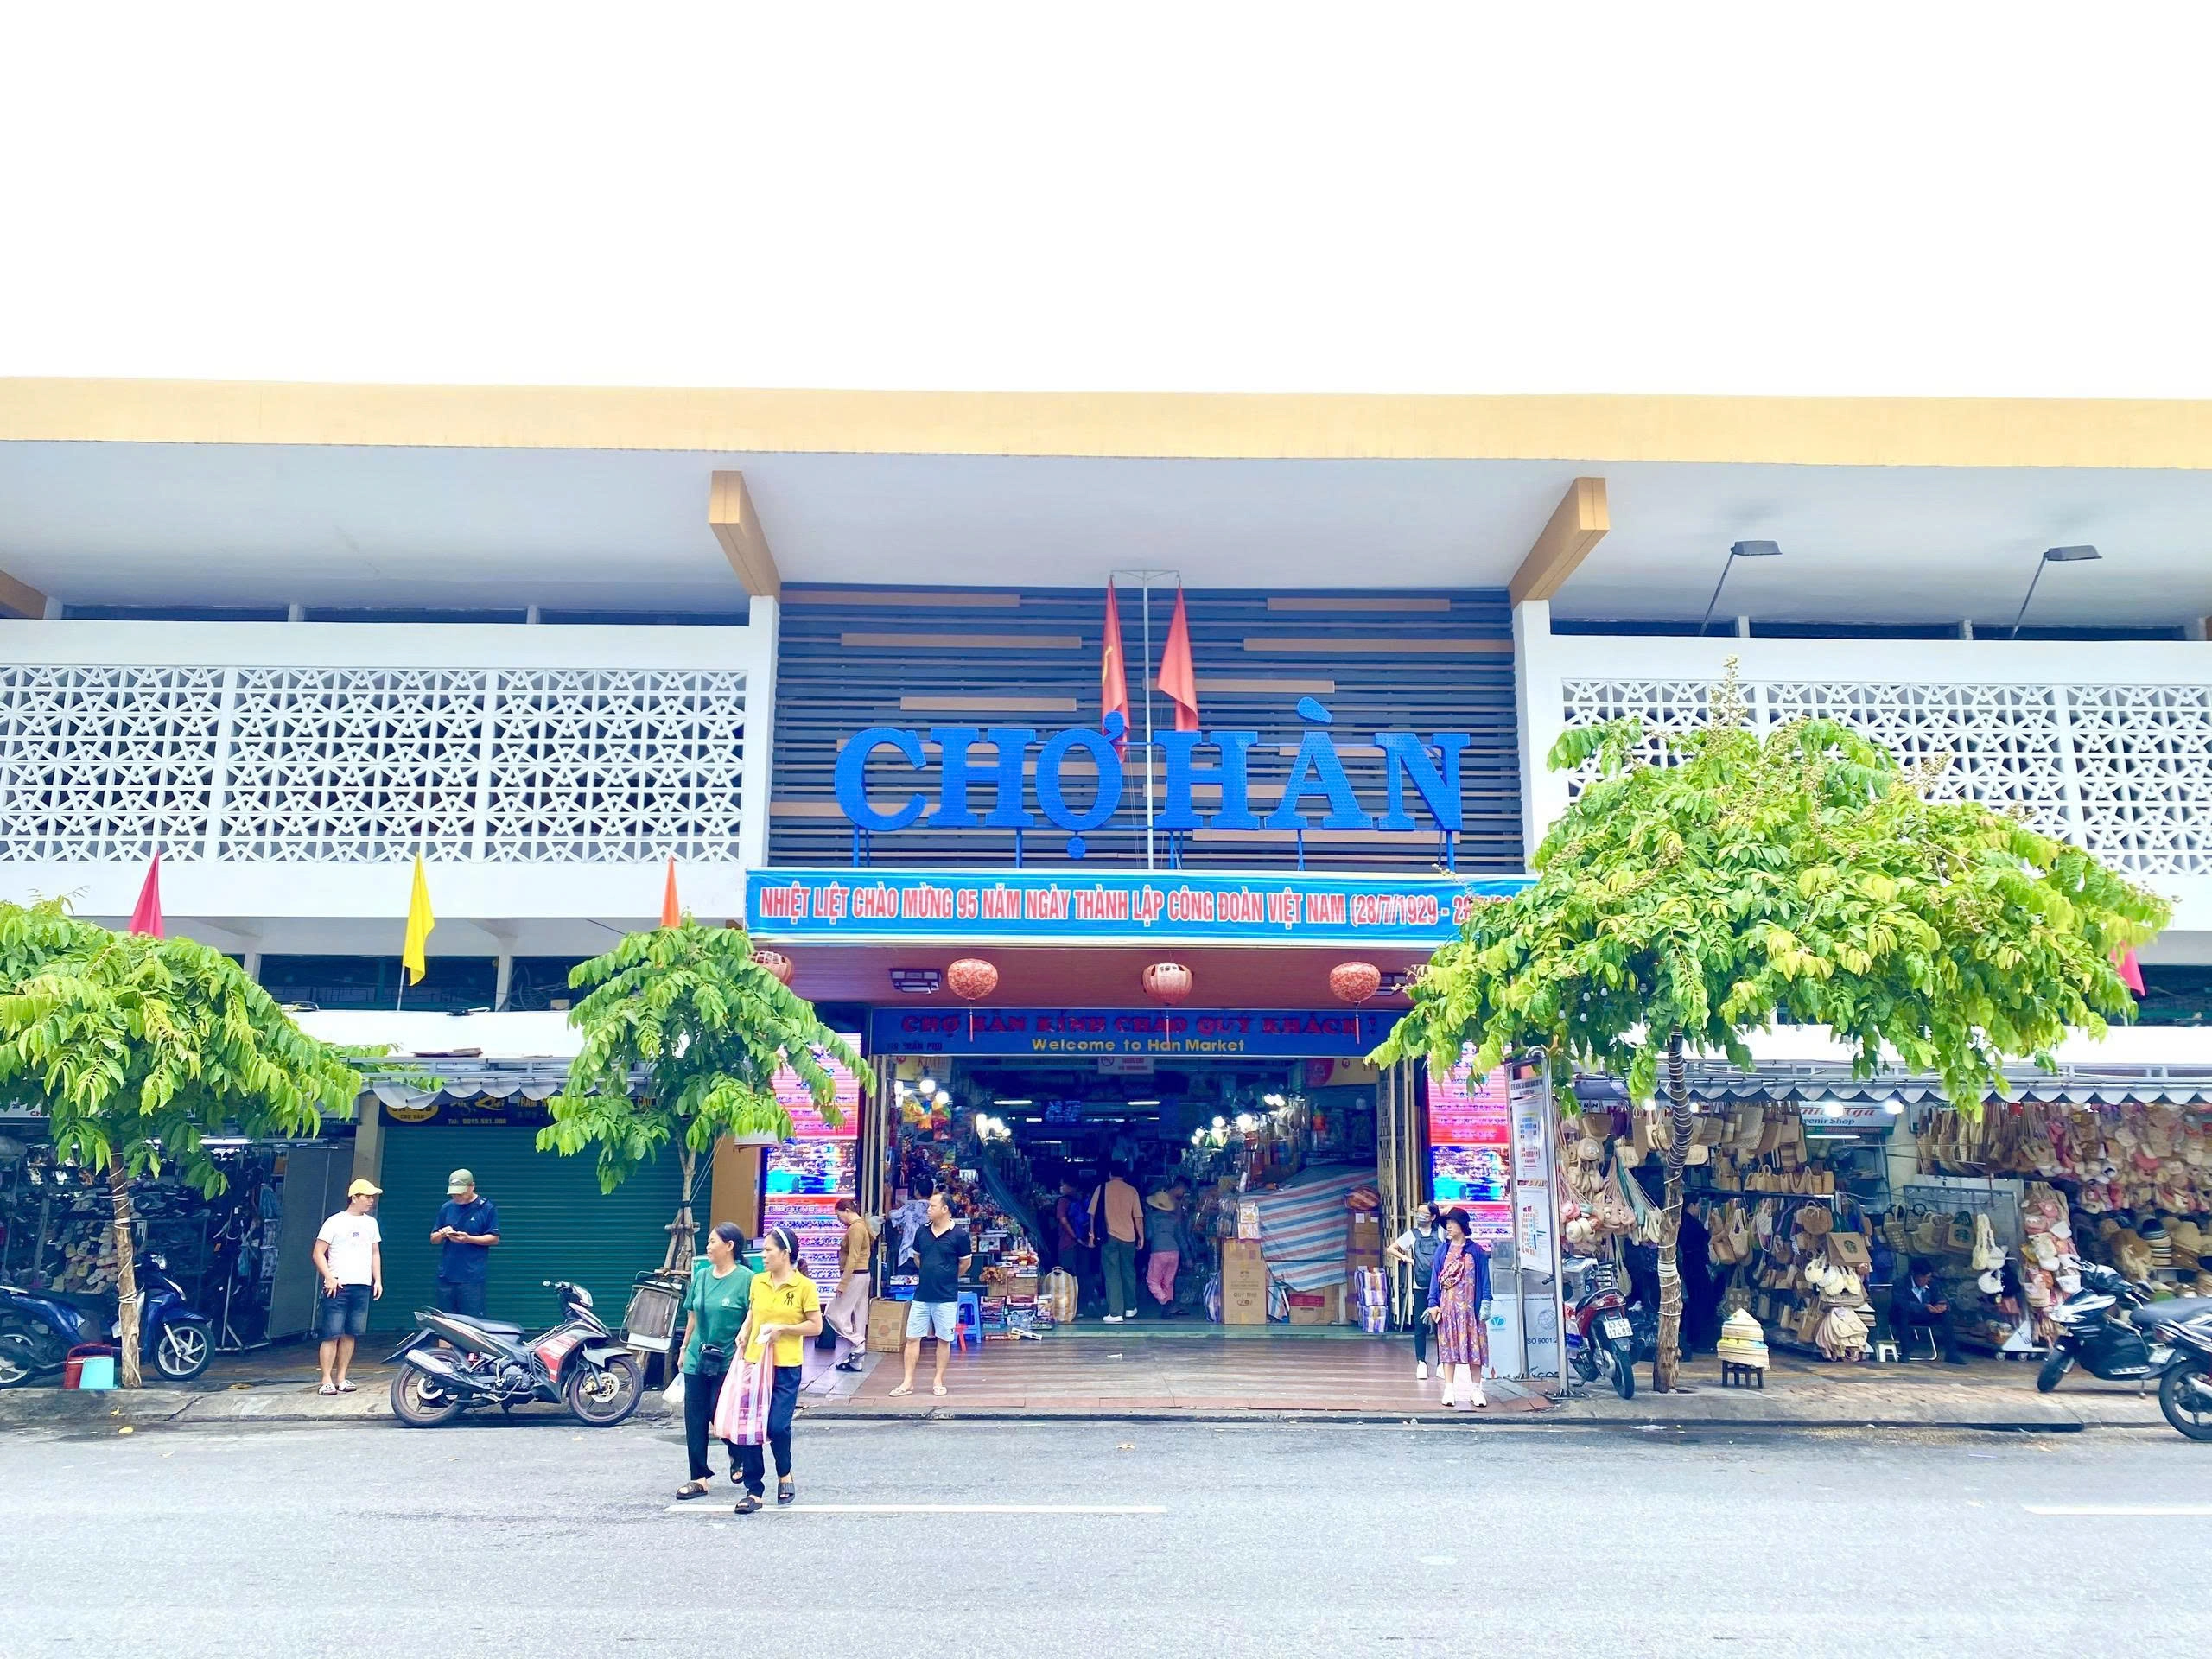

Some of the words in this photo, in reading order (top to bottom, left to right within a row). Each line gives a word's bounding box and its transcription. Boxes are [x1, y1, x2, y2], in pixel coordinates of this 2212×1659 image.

[835, 711, 1124, 859] CHỢ
[1154, 696, 1471, 831] HÀN
[760, 881, 810, 924] NHIỆT
[814, 881, 849, 924] LIỆT
[853, 881, 898, 918] CHÀO
[903, 883, 952, 919] MỪNG
[957, 887, 977, 919] 95
[982, 882, 1021, 919] NĂM
[1026, 883, 1070, 920] NGÀY
[1074, 884, 1128, 921] THÀNH
[1132, 885, 1164, 927] LẬP
[1167, 885, 1213, 922] CÔNG
[1217, 886, 1266, 923] ĐOÀN
[1268, 888, 1306, 930] VIỆT
[1307, 893, 1346, 924] NAM
[1350, 894, 1438, 928] (28/7/1929
[901, 1015, 961, 1037] CHỢ
[969, 1009, 1027, 1033] HÀN
[1037, 1009, 1107, 1033] KÍNH
[1033, 1039, 1115, 1052] Welcome
[1124, 1039, 1141, 1052] to
[1148, 1039, 1180, 1052] Han
[1185, 1039, 1245, 1052] Market
